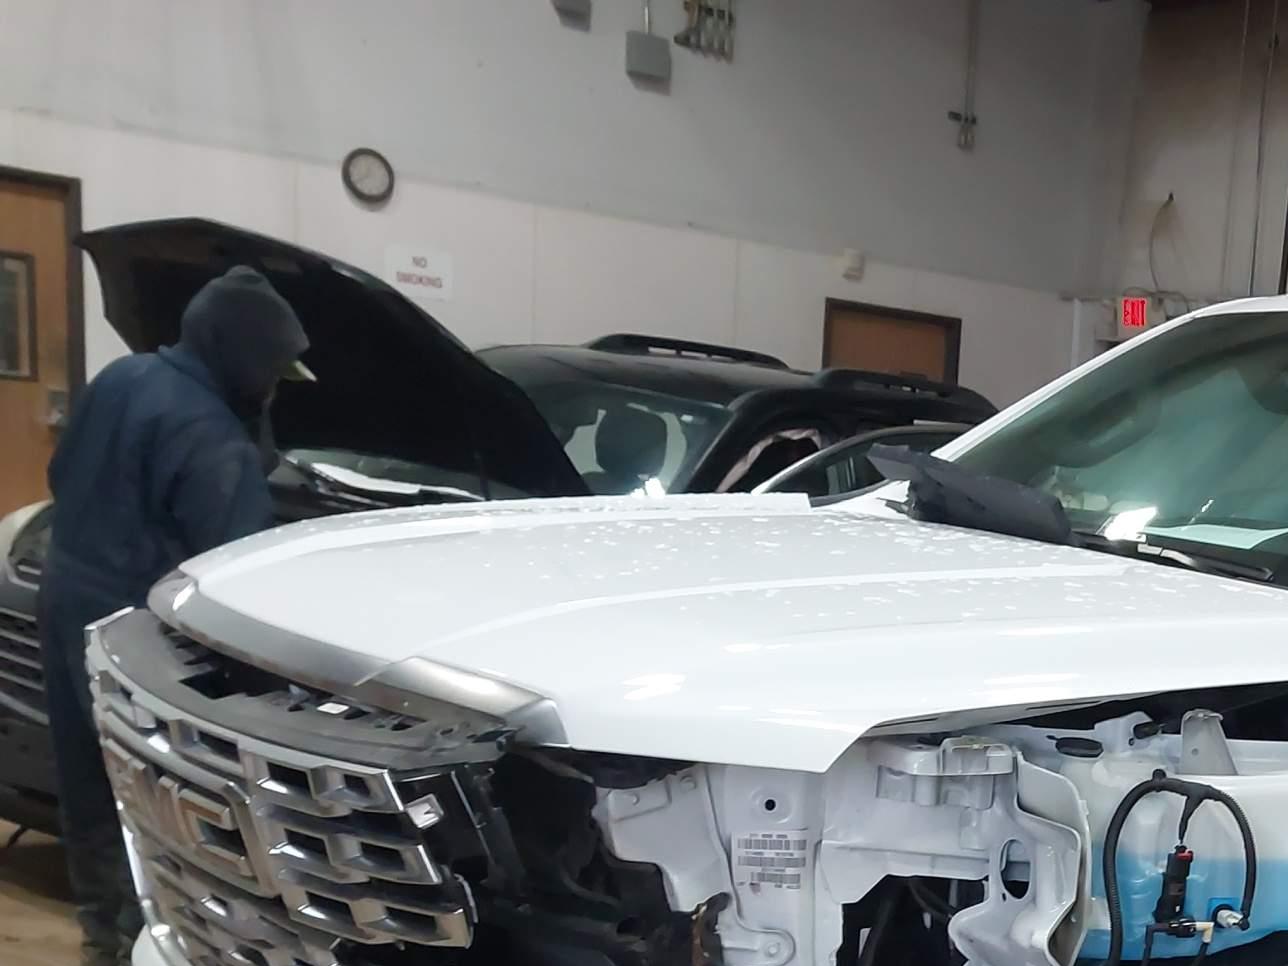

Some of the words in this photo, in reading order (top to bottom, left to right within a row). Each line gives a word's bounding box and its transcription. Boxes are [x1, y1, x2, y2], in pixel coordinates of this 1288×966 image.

[412, 256, 428, 269] NO
[396, 271, 443, 289] SMOKING
[1123, 299, 1146, 327] EXIT
